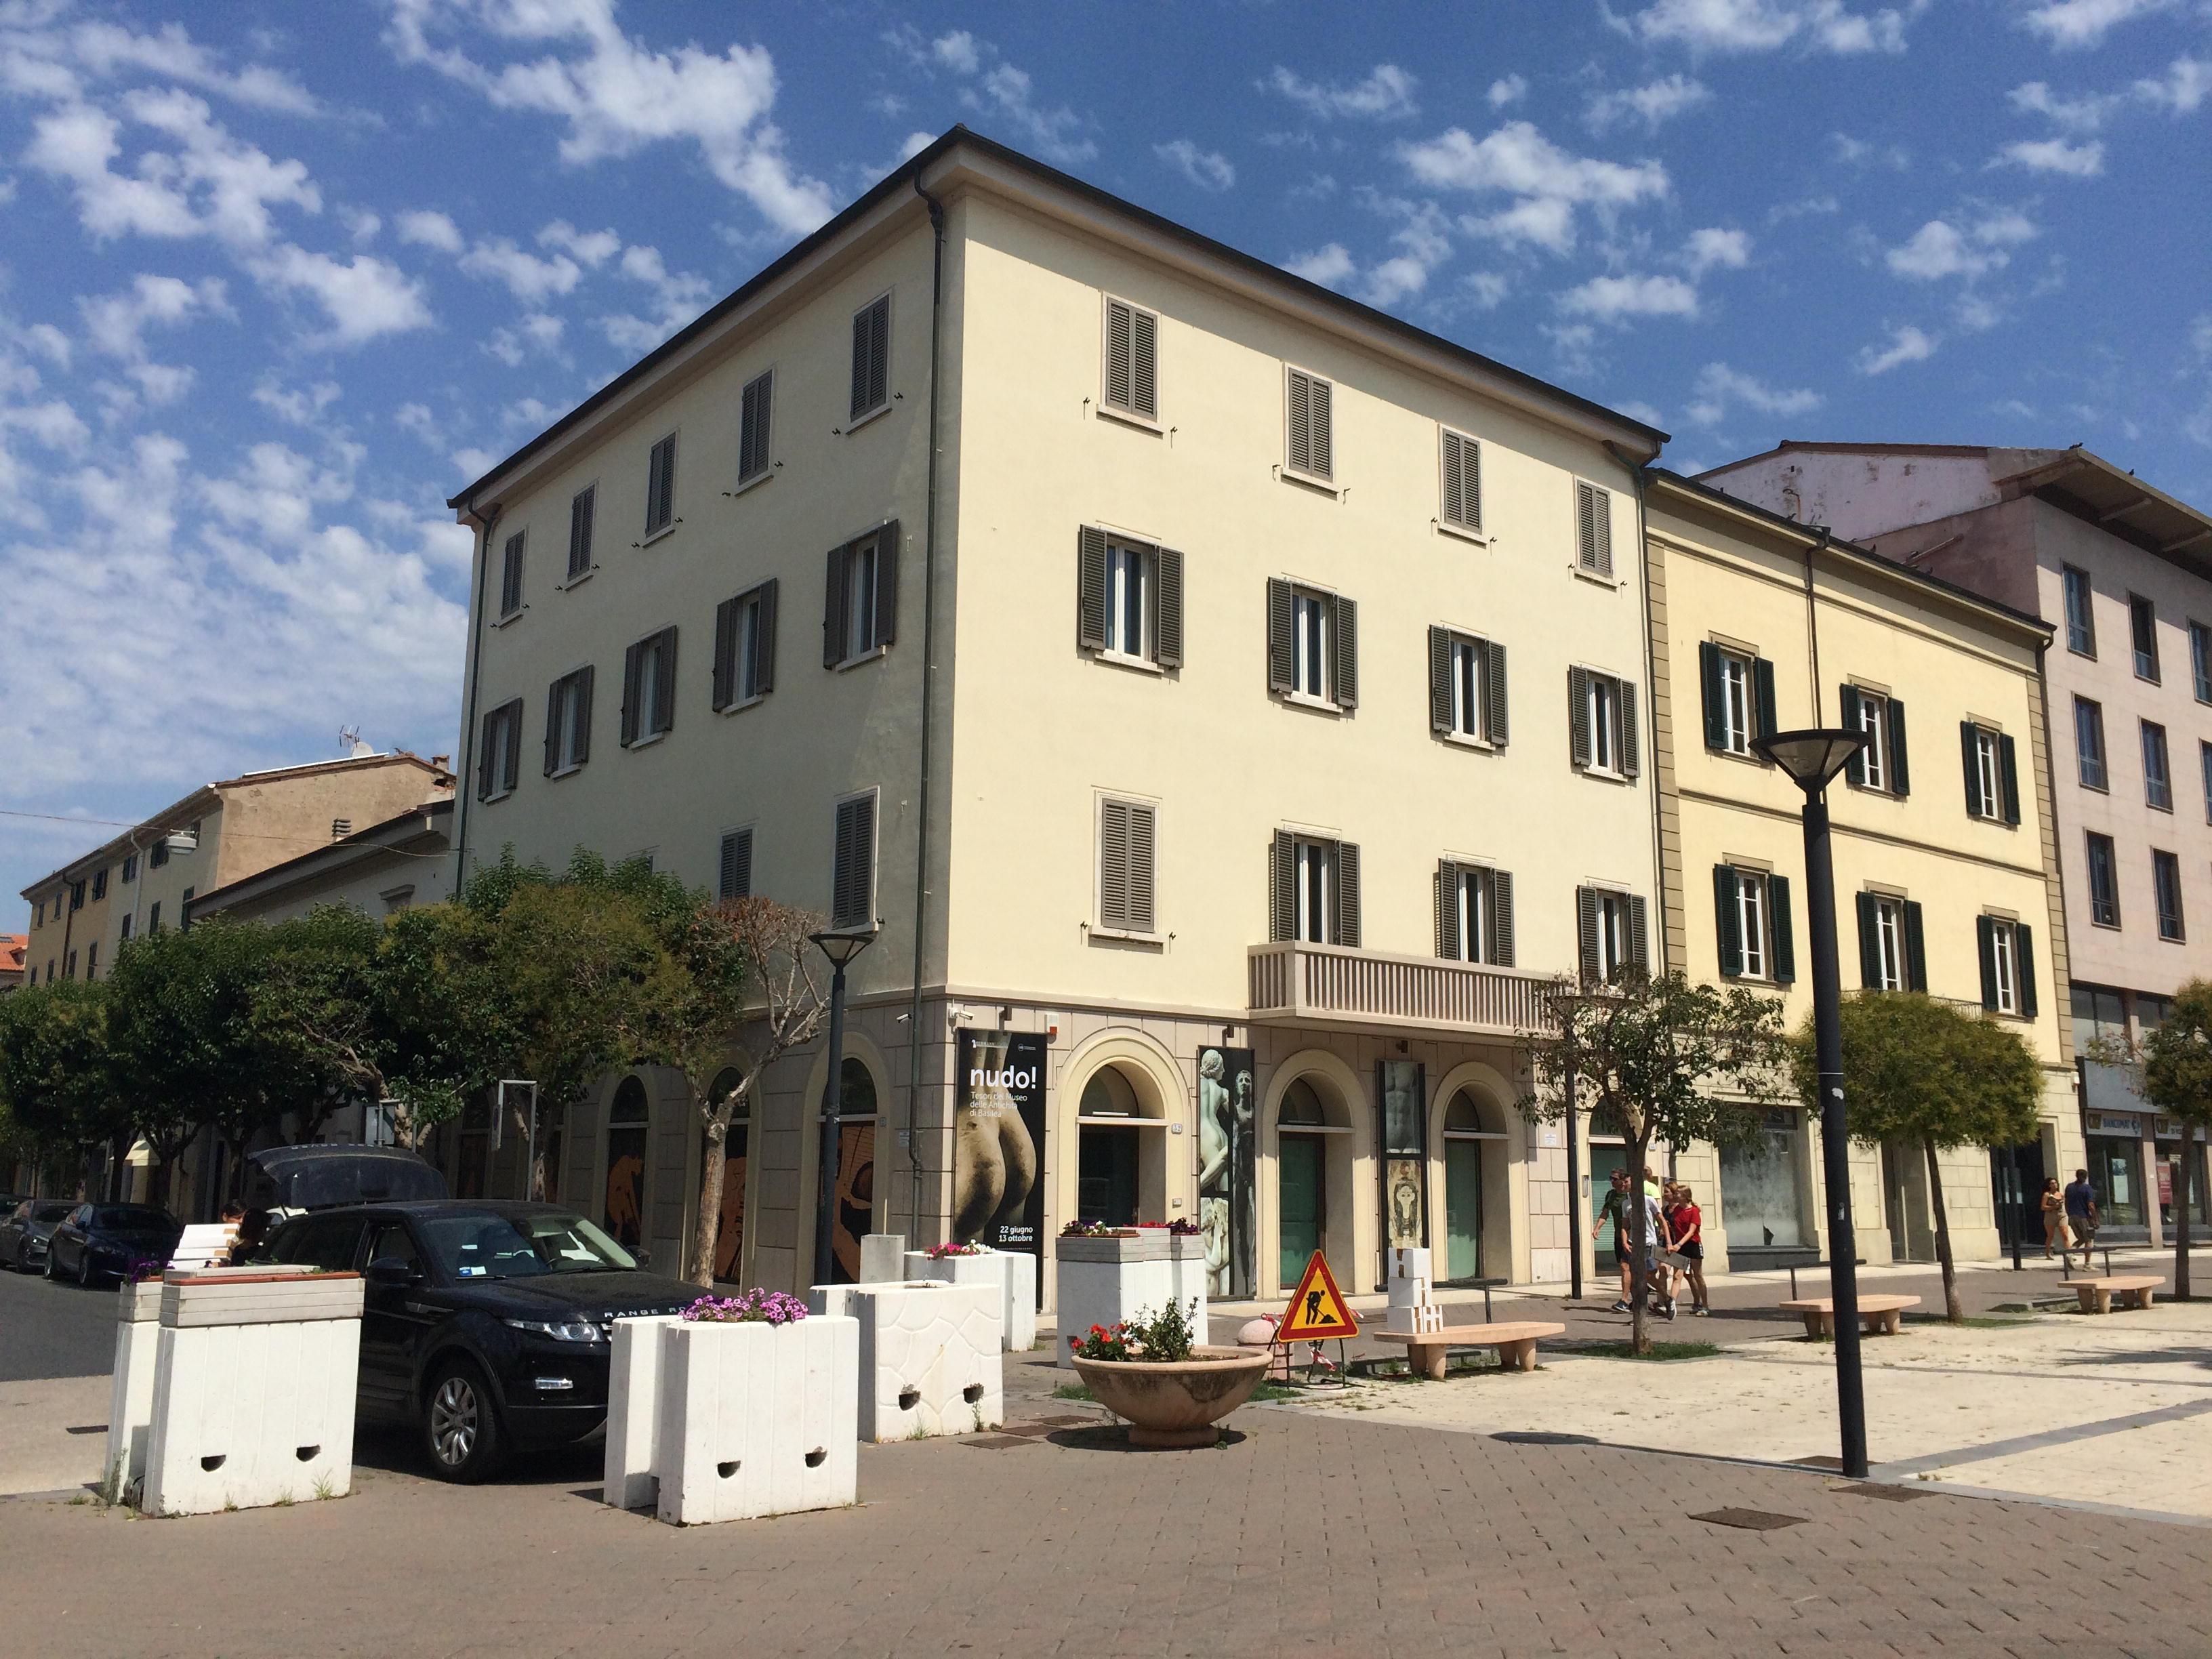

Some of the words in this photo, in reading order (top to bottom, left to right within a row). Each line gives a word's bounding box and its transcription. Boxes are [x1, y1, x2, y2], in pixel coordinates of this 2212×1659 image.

[970, 1065, 1036, 1089] nudo!
[1006, 1092, 1028, 1102] Museo
[970, 1100, 987, 1108] delle
[978, 1109, 1002, 1118] Basilea
[1000, 1225, 1008, 1233] 22
[1010, 1226, 1033, 1235] giugno
[604, 1309, 659, 1317] RANGE
